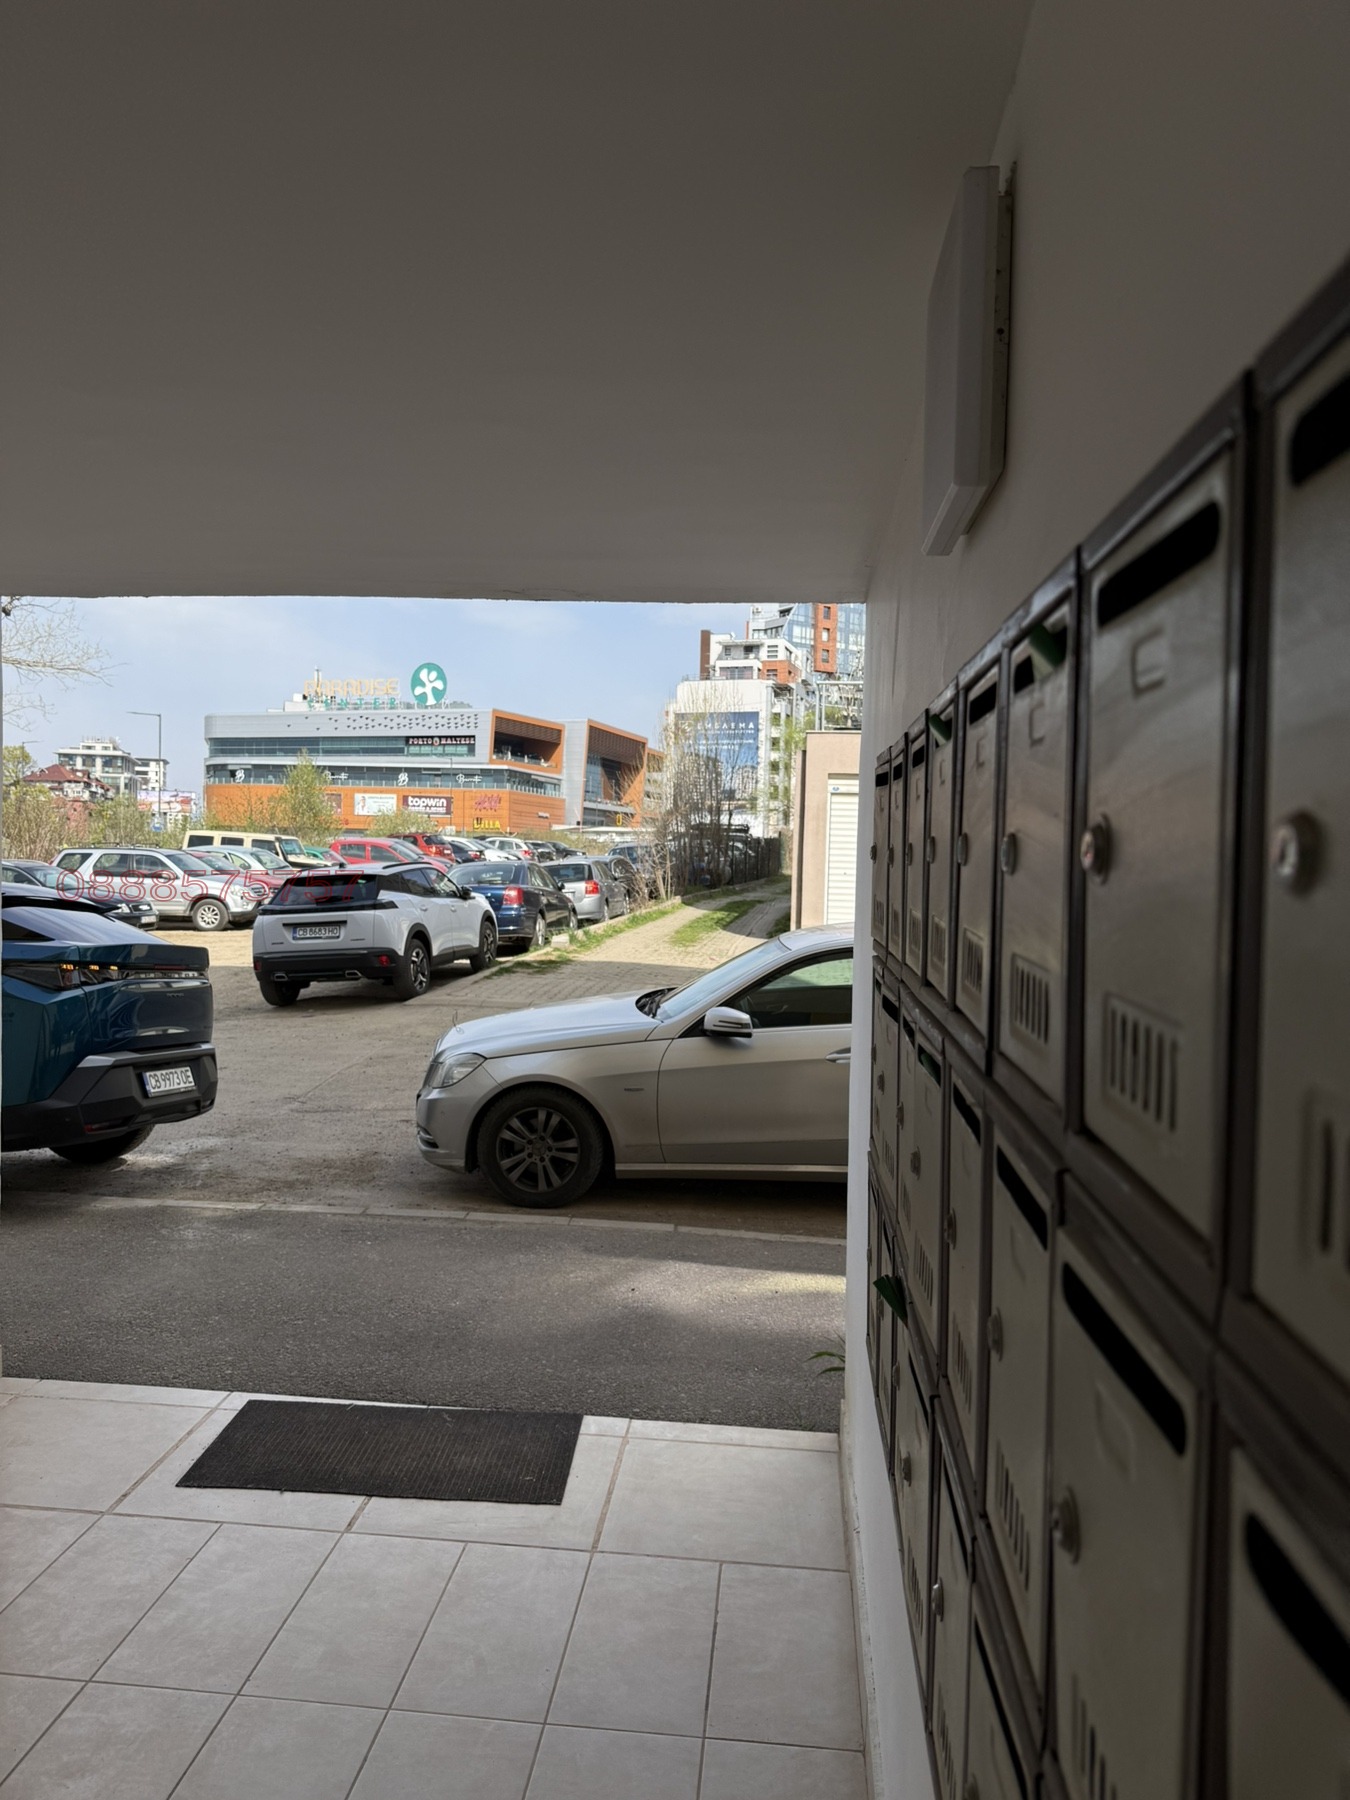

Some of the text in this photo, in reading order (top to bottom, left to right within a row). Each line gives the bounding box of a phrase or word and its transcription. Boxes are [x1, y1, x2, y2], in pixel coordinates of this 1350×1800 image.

[304, 678, 399, 696] PARADISE
[409, 737, 433, 745] PORTO
[407, 796, 447, 808] topwin
[160, 1070, 181, 1088] 9973
